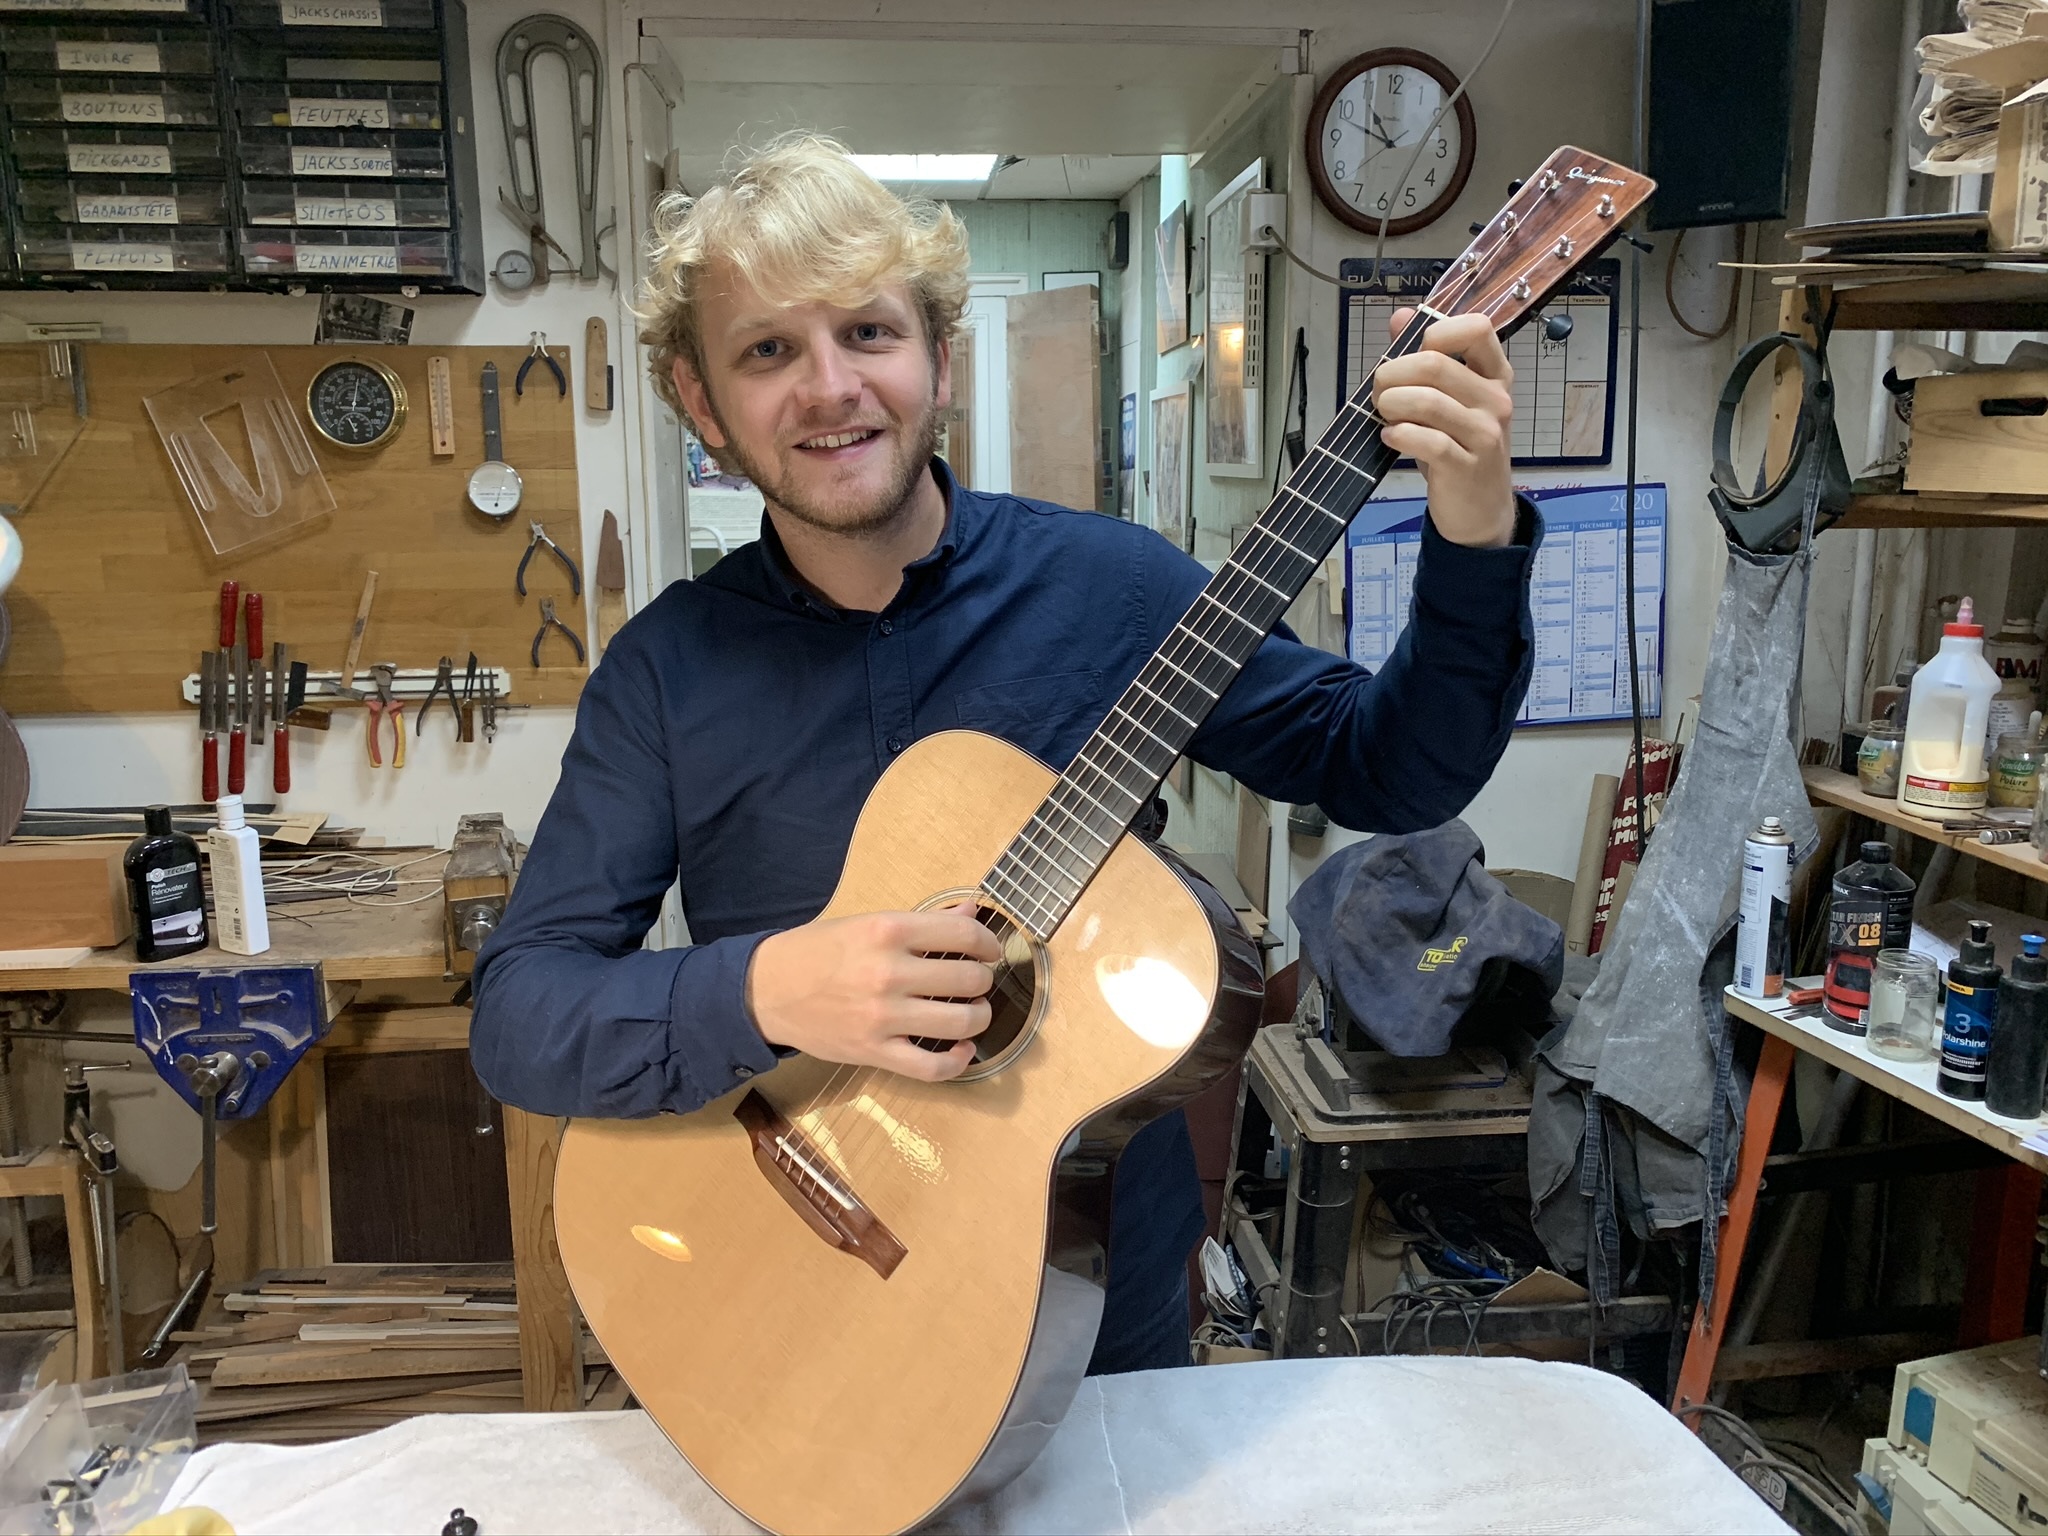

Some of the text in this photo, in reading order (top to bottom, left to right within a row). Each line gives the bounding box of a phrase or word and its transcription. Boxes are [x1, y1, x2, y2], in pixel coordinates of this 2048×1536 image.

[288, 7, 330, 19] JACKS
[71, 53, 134, 65] IVOIRE
[1362, 79, 1375, 100] 11
[1388, 74, 1404, 95] 12
[1418, 85, 1424, 106] 1
[70, 102, 157, 116] BOUTONS
[296, 106, 384, 125] FEUTRES
[1339, 99, 1354, 120] 10
[1330, 128, 1343, 148] 9
[1436, 139, 1447, 158] 3
[296, 154, 393, 171] JACKS SORTIE
[1334, 160, 1345, 180] 8
[1424, 168, 1436, 187] 4
[1354, 183, 1364, 202] 7
[1377, 192, 1389, 211] 6
[1404, 188, 1416, 207] 5
[1999, 774, 2028, 787] Poivre
[1858, 923, 1881, 939] 08
[1954, 1013, 1971, 1034] 3
